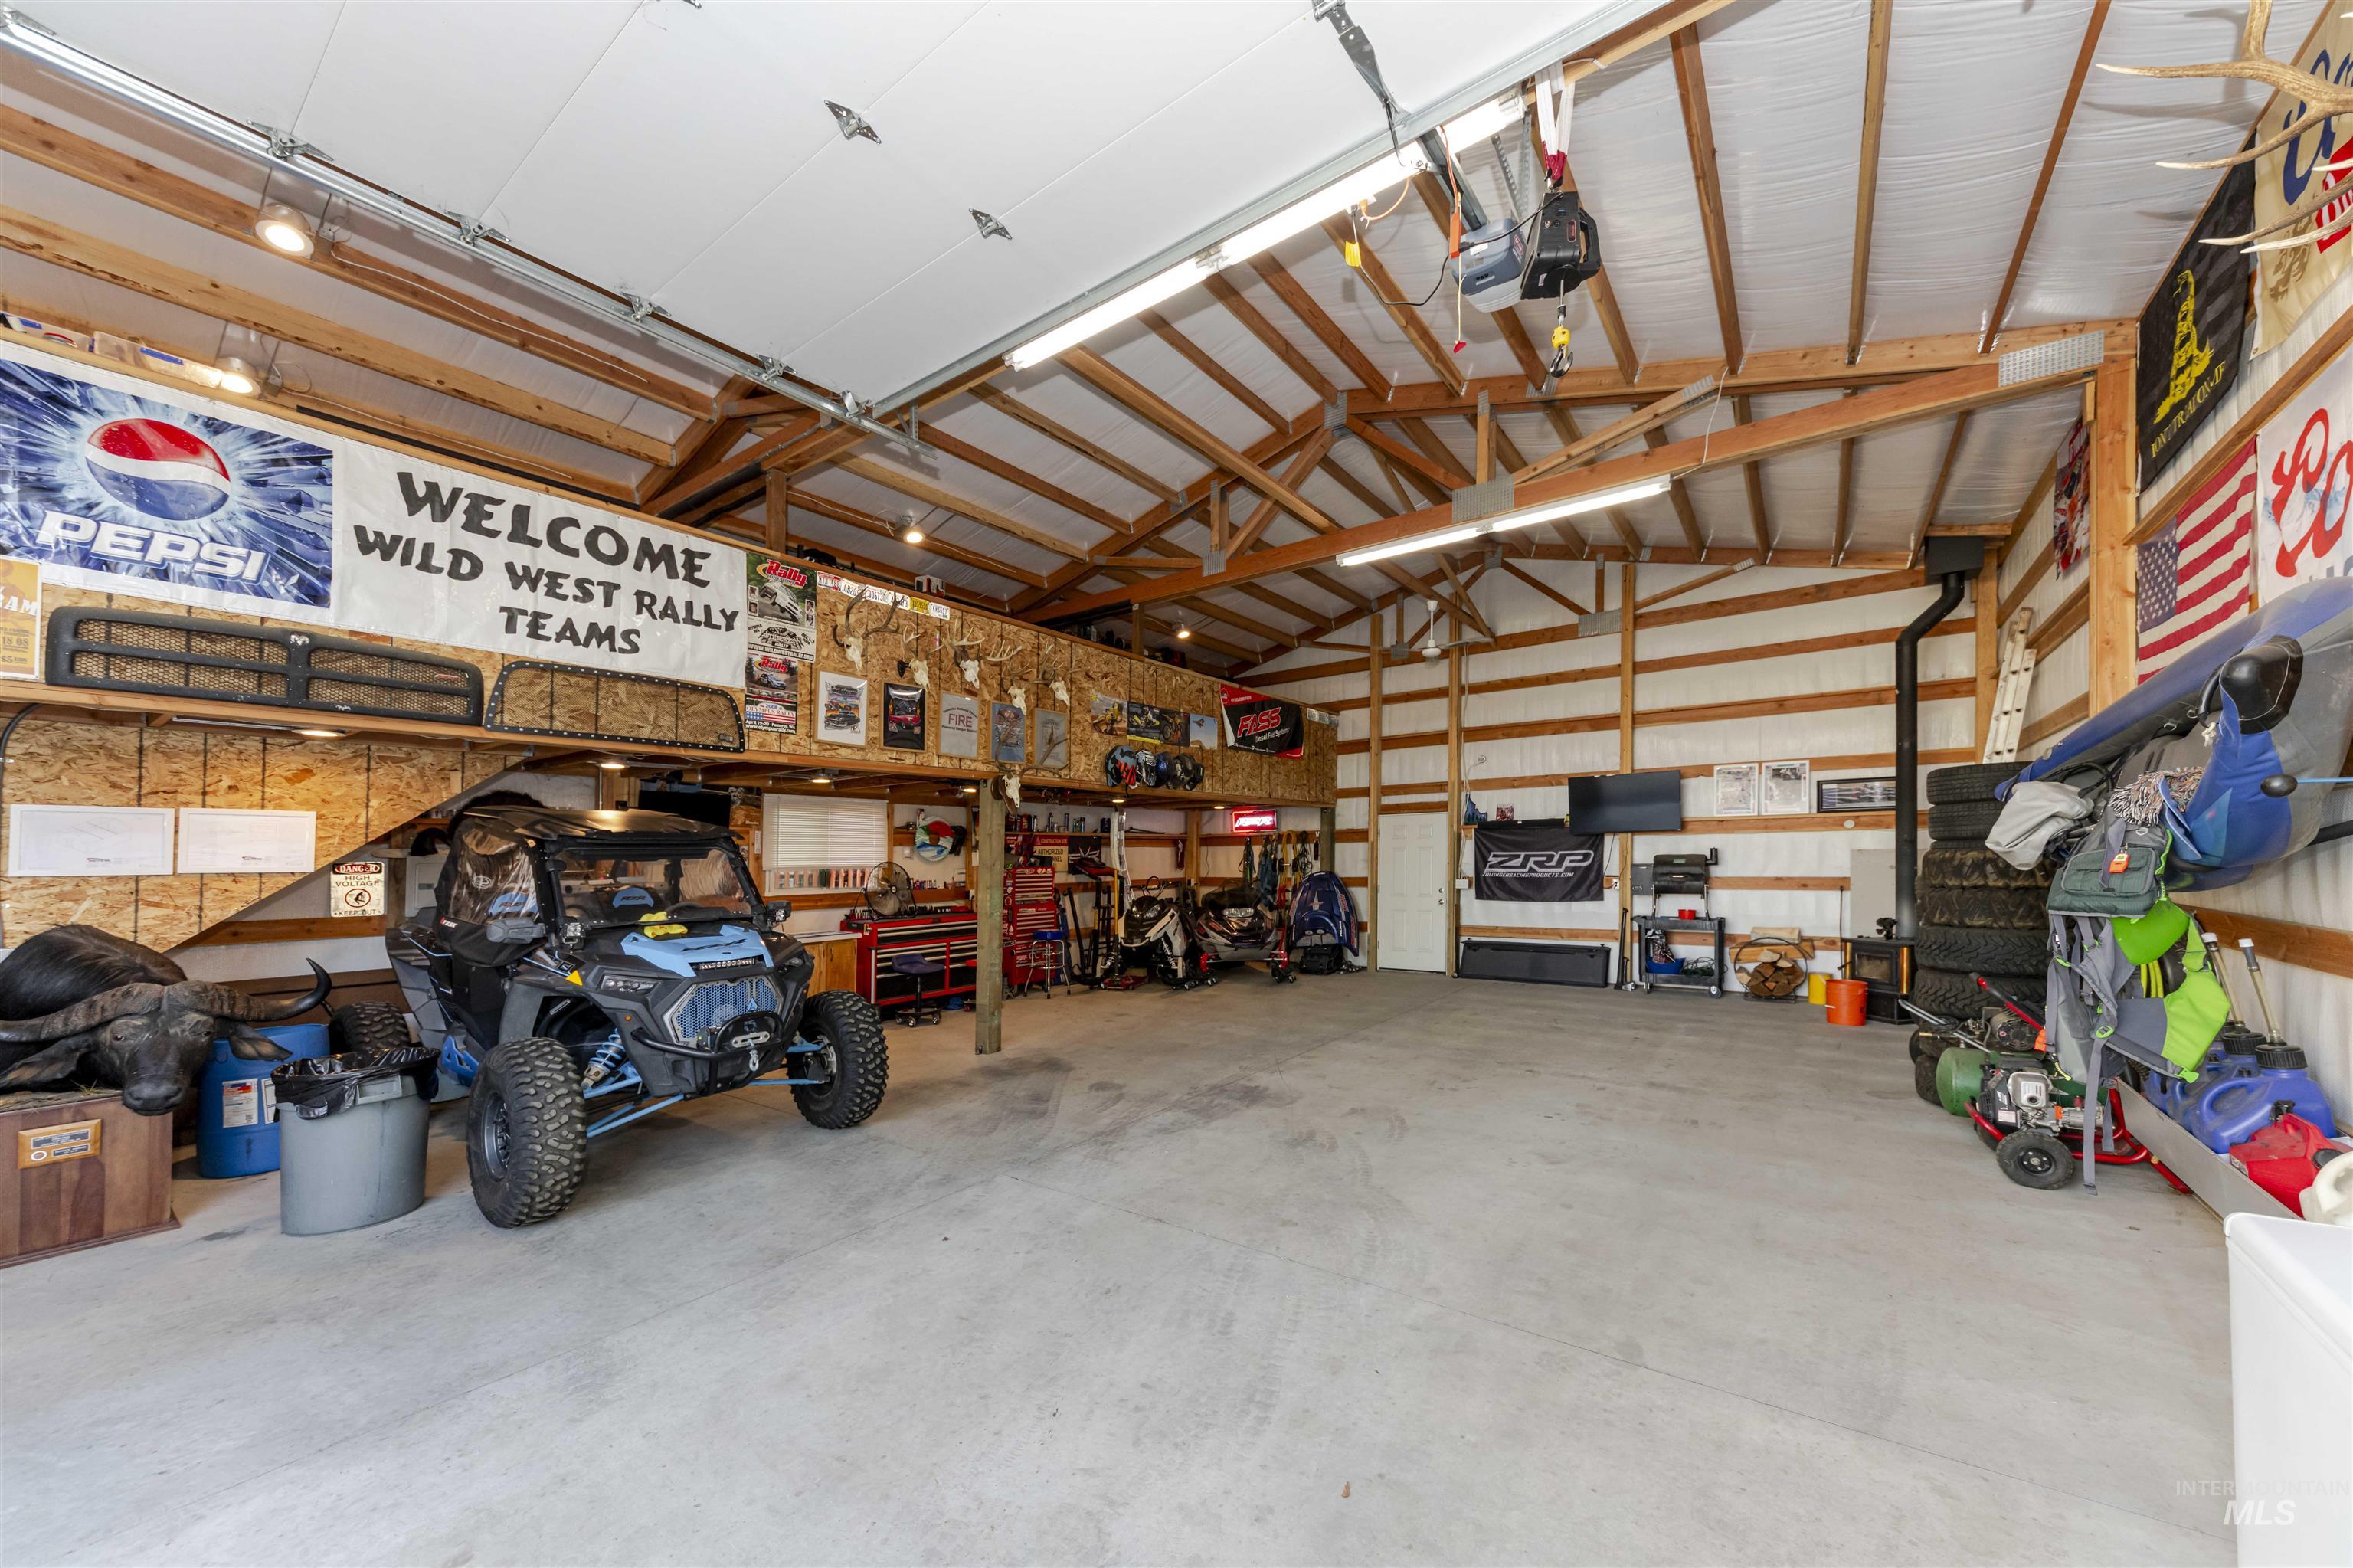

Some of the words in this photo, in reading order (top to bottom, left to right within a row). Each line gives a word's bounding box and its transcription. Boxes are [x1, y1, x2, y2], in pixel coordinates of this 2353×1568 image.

[397, 471, 712, 588] WELCOME
[38, 512, 268, 582] PEPSI
[354, 525, 484, 581] WILD
[505, 561, 621, 607] WEST
[634, 589, 739, 632] RALLY
[766, 559, 807, 588] Rally
[499, 606, 640, 654] TEAMS
[948, 713, 972, 728] FIRE
[1237, 707, 1281, 738] FASS
[1255, 734, 1268, 743] Diesel
[339, 864, 378, 872] DANGER
[1484, 850, 1594, 873] ZRP
